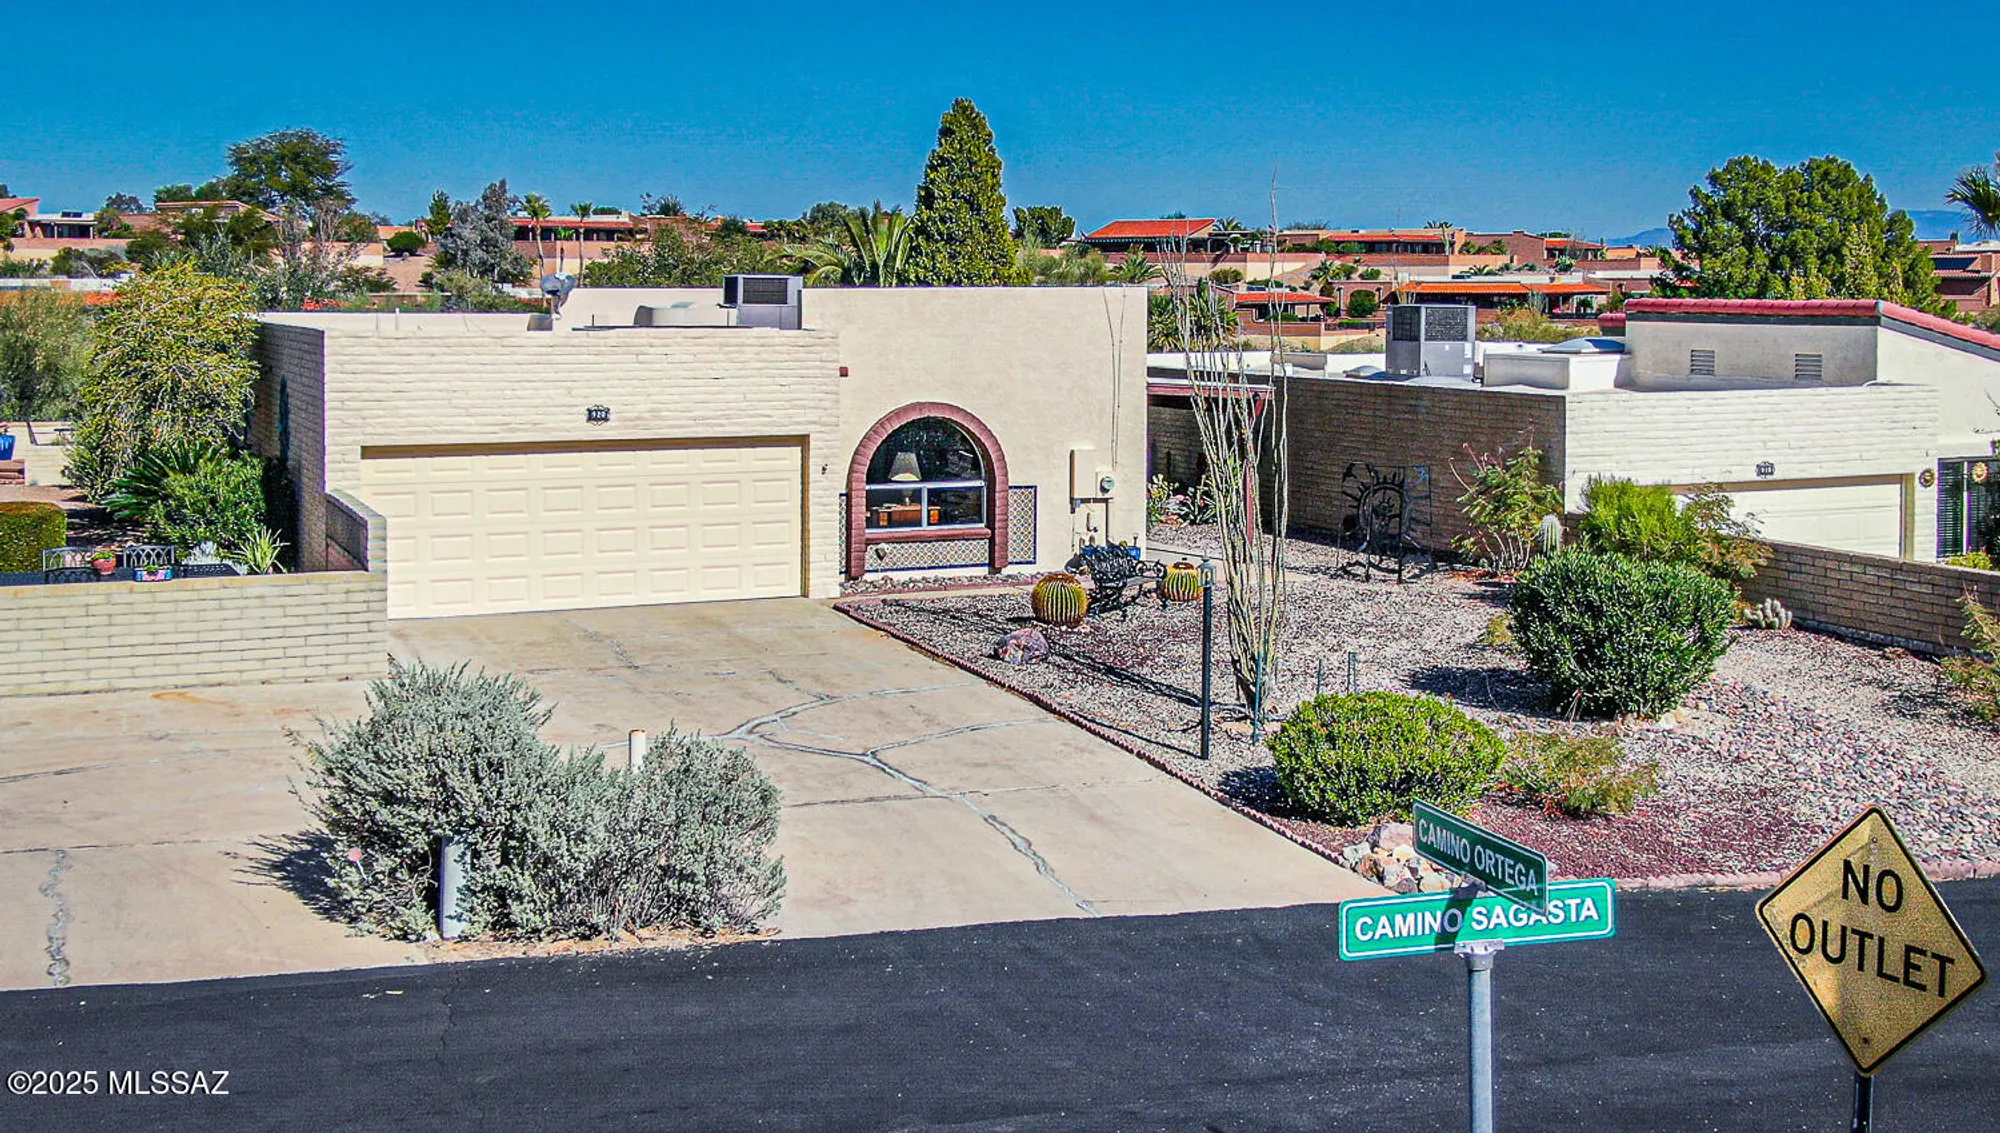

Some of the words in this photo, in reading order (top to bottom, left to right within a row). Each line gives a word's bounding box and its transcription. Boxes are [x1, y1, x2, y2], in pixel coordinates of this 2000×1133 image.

[1418, 818, 1471, 864] CAMINO
[1474, 845, 1539, 896] ORTEGA
[1842, 858, 1903, 912] NO
[1354, 908, 1463, 942] CAMINO
[1790, 912, 1955, 998] OUTLET
